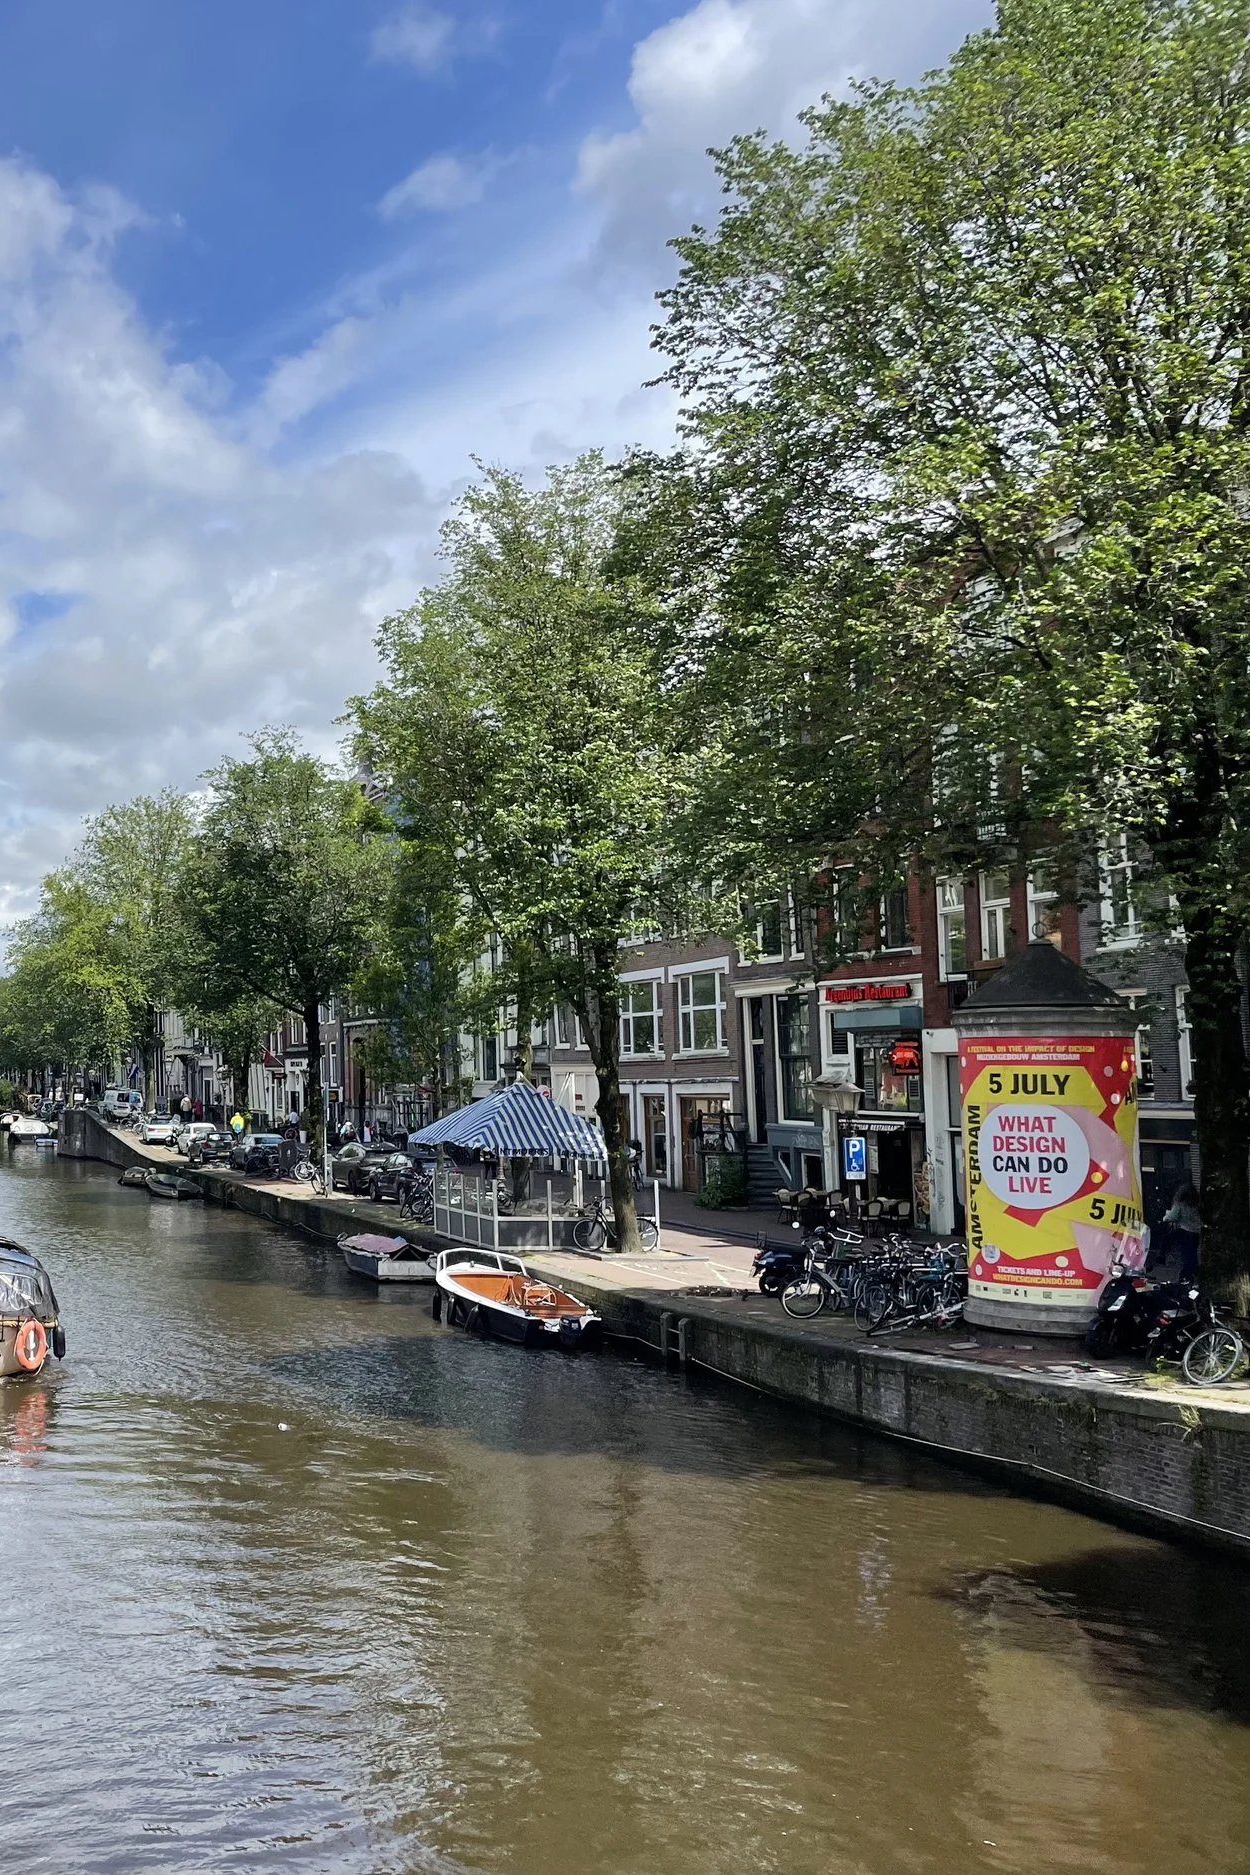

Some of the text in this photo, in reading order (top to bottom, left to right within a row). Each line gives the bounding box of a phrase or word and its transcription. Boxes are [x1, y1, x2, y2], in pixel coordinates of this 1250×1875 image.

[863, 982, 910, 1001] Restaurant
[1007, 1045, 1023, 1053] THE
[1024, 1045, 1055, 1053] IMPACT
[1056, 1045, 1068, 1053] OF
[1031, 1053, 1081, 1061] AMSTERDAM
[988, 1073, 1071, 1096] 5 JULY
[997, 1115, 1057, 1134] WHAT
[849, 1140, 861, 1159] P
[992, 1135, 1066, 1154] DESIGN
[992, 1155, 1069, 1174] CAN DO
[1008, 1176, 1053, 1195] LIVE
[1089, 1197, 1106, 1221] 5
[992, 1273, 1083, 1287] WHATDESIGNCANDO.COM
[996, 1265, 1076, 1278] TICKETS AND LINE-UP
